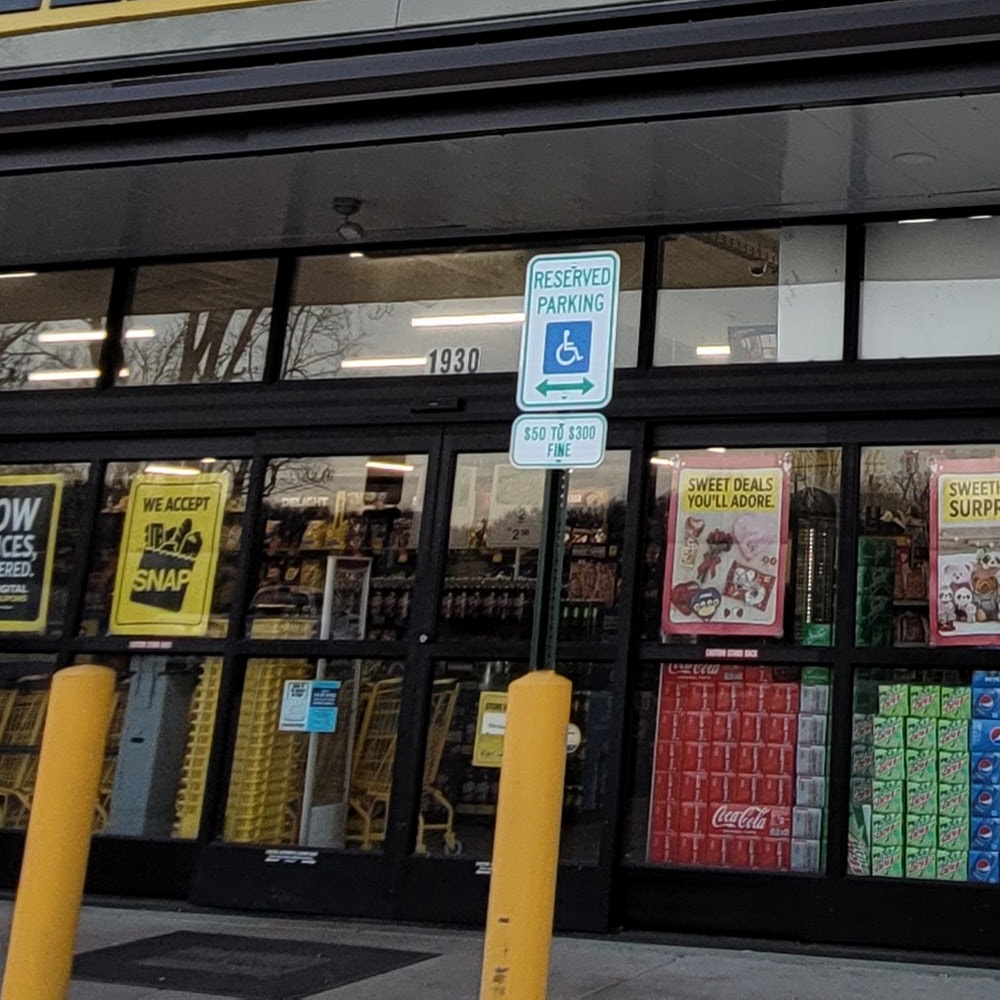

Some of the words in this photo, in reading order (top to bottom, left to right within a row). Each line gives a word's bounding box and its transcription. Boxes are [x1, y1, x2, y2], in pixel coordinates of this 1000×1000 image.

[534, 267, 611, 289] RESERVED
[537, 294, 604, 314] PARKING
[429, 347, 480, 374] 1930
[524, 427, 546, 441] $50
[551, 425, 564, 440] TO
[568, 425, 596, 440] $300
[547, 443, 571, 458] FINE
[688, 477, 731, 492] SWEET
[733, 477, 773, 491] DEALS
[143, 497, 162, 512] WE
[164, 496, 211, 512] ACCEPT
[687, 495, 728, 508] YOU'LL
[730, 494, 775, 508] ADORE.
[133, 569, 191, 592] SNAP
